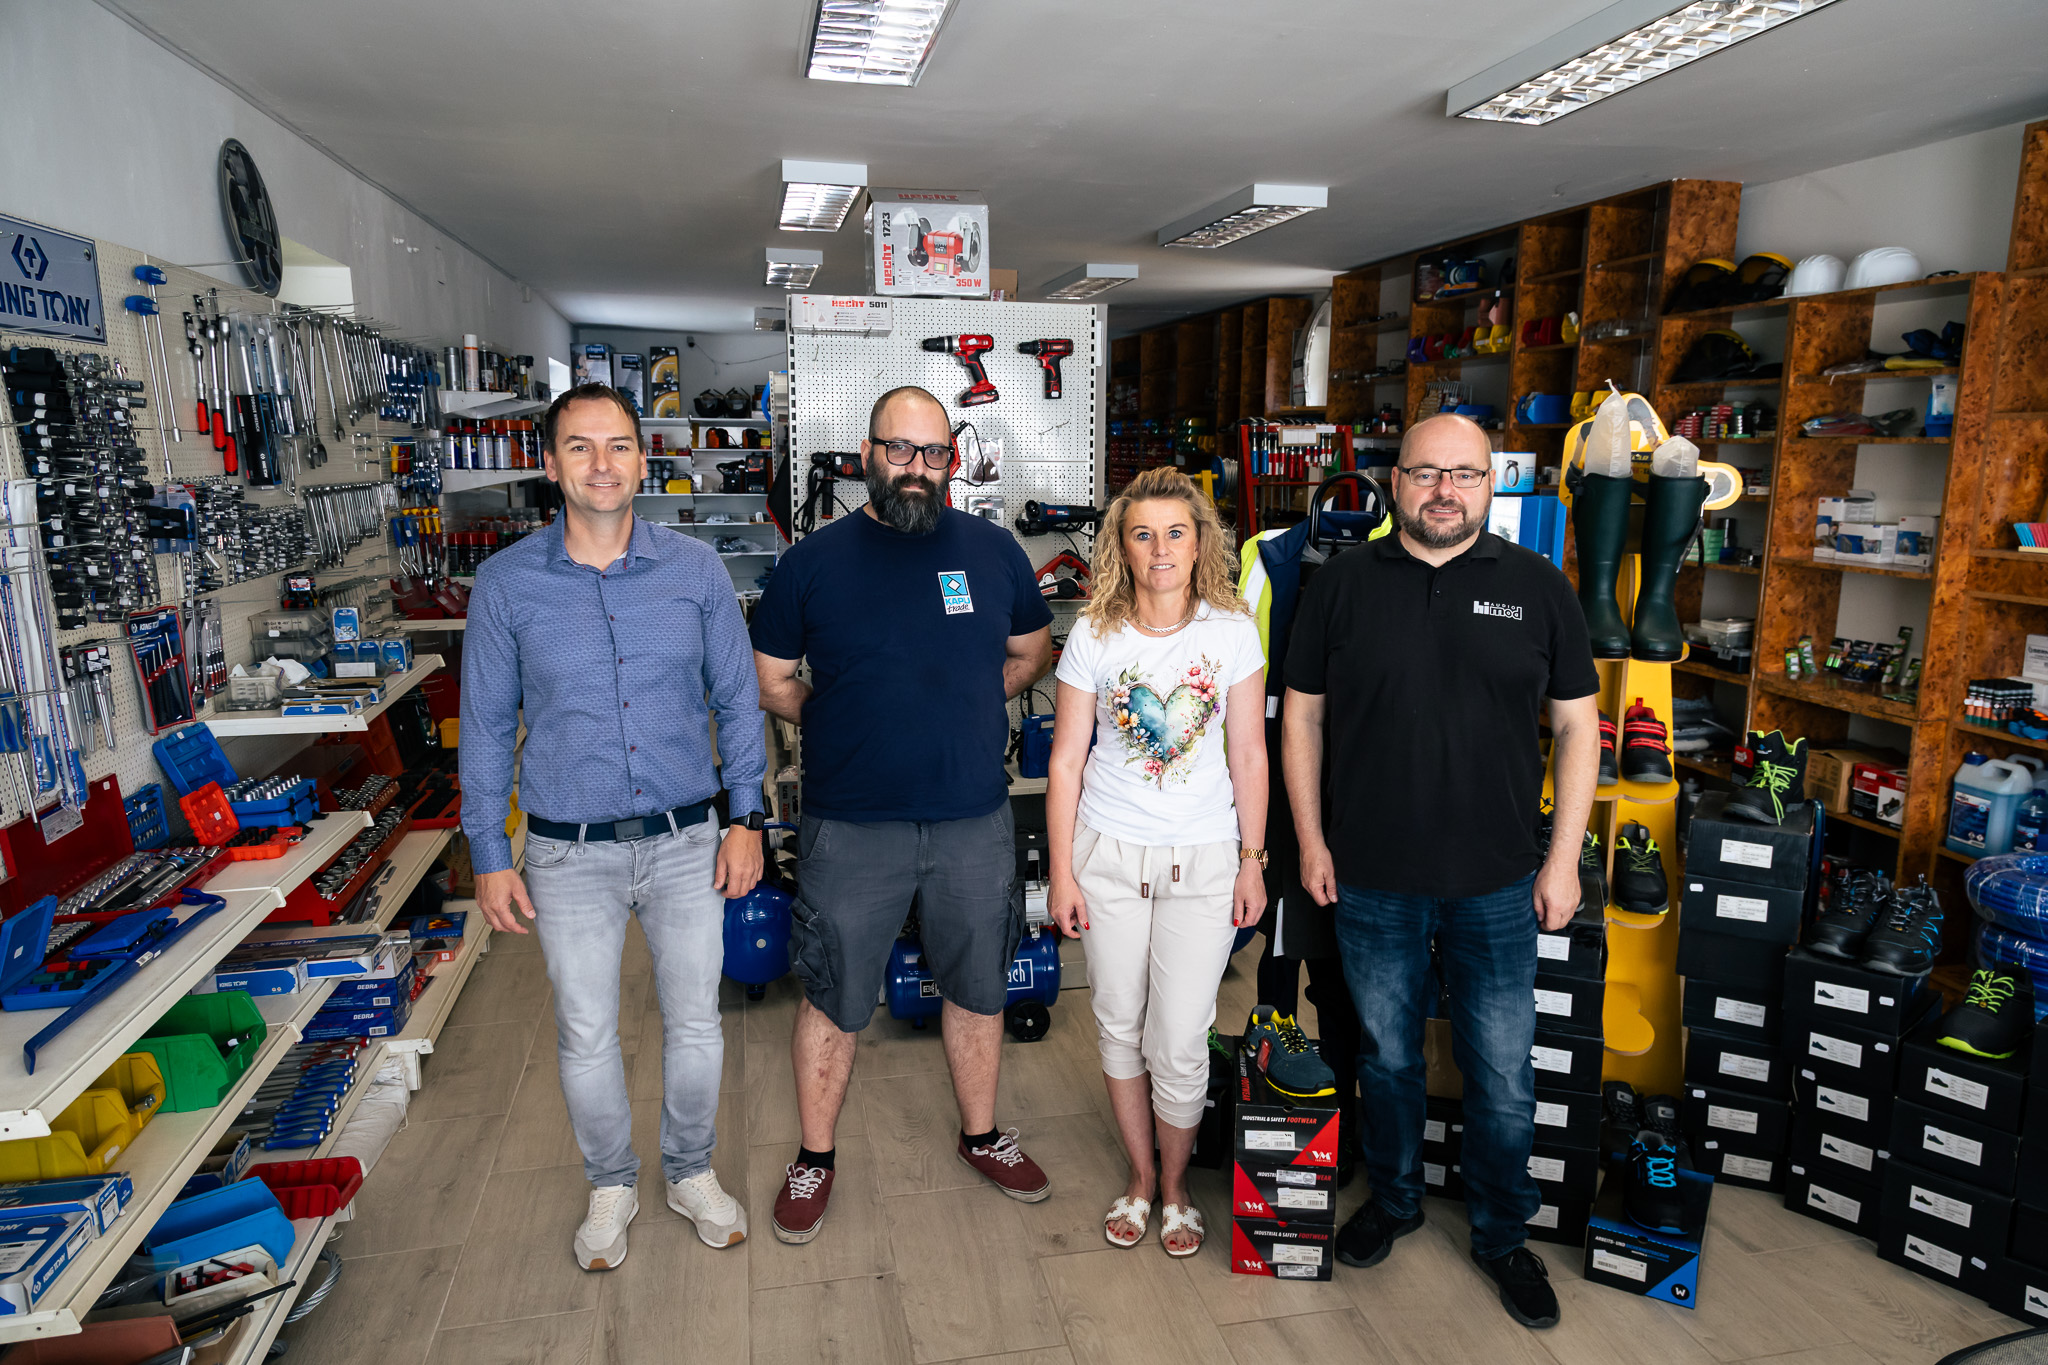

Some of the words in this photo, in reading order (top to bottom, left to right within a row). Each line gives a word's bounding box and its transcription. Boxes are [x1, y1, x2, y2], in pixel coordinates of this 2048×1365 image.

[882, 212, 890, 238] 1723
[956, 279, 972, 287] 350
[974, 279, 982, 287] W
[0, 281, 37, 318] ING
[37, 289, 90, 327] TONY
[869, 301, 888, 309] 5011
[353, 1012, 375, 1020] DEDRA
[1286, 1117, 1317, 1125] FOOTWEAR
[1298, 1232, 1329, 1240] FOOTWEAR
[1675, 1287, 1686, 1297] W
